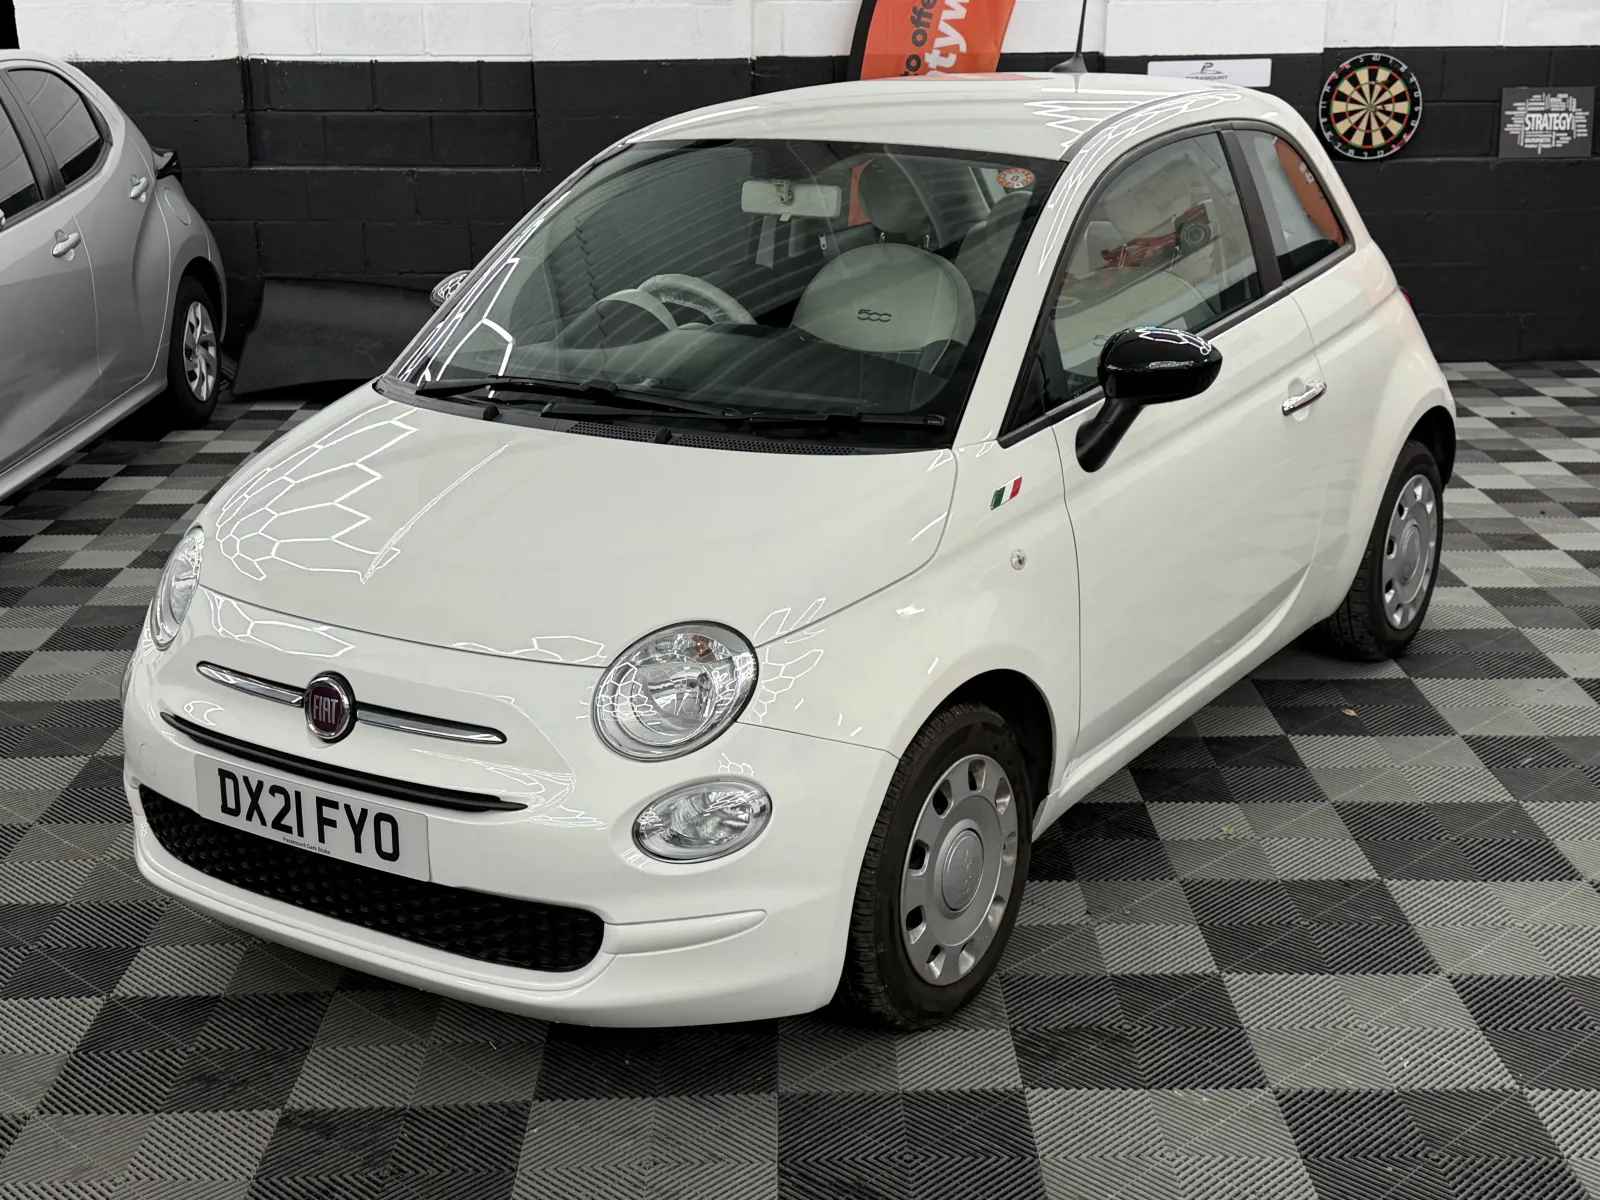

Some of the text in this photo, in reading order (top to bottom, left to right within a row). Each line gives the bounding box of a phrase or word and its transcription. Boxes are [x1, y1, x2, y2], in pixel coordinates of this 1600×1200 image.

[1524, 112, 1574, 131] STRATEGY
[857, 308, 892, 323] 500
[313, 694, 339, 725] FIAT
[217, 767, 400, 862] DX21 FYO
[282, 836, 307, 849] Paramount
